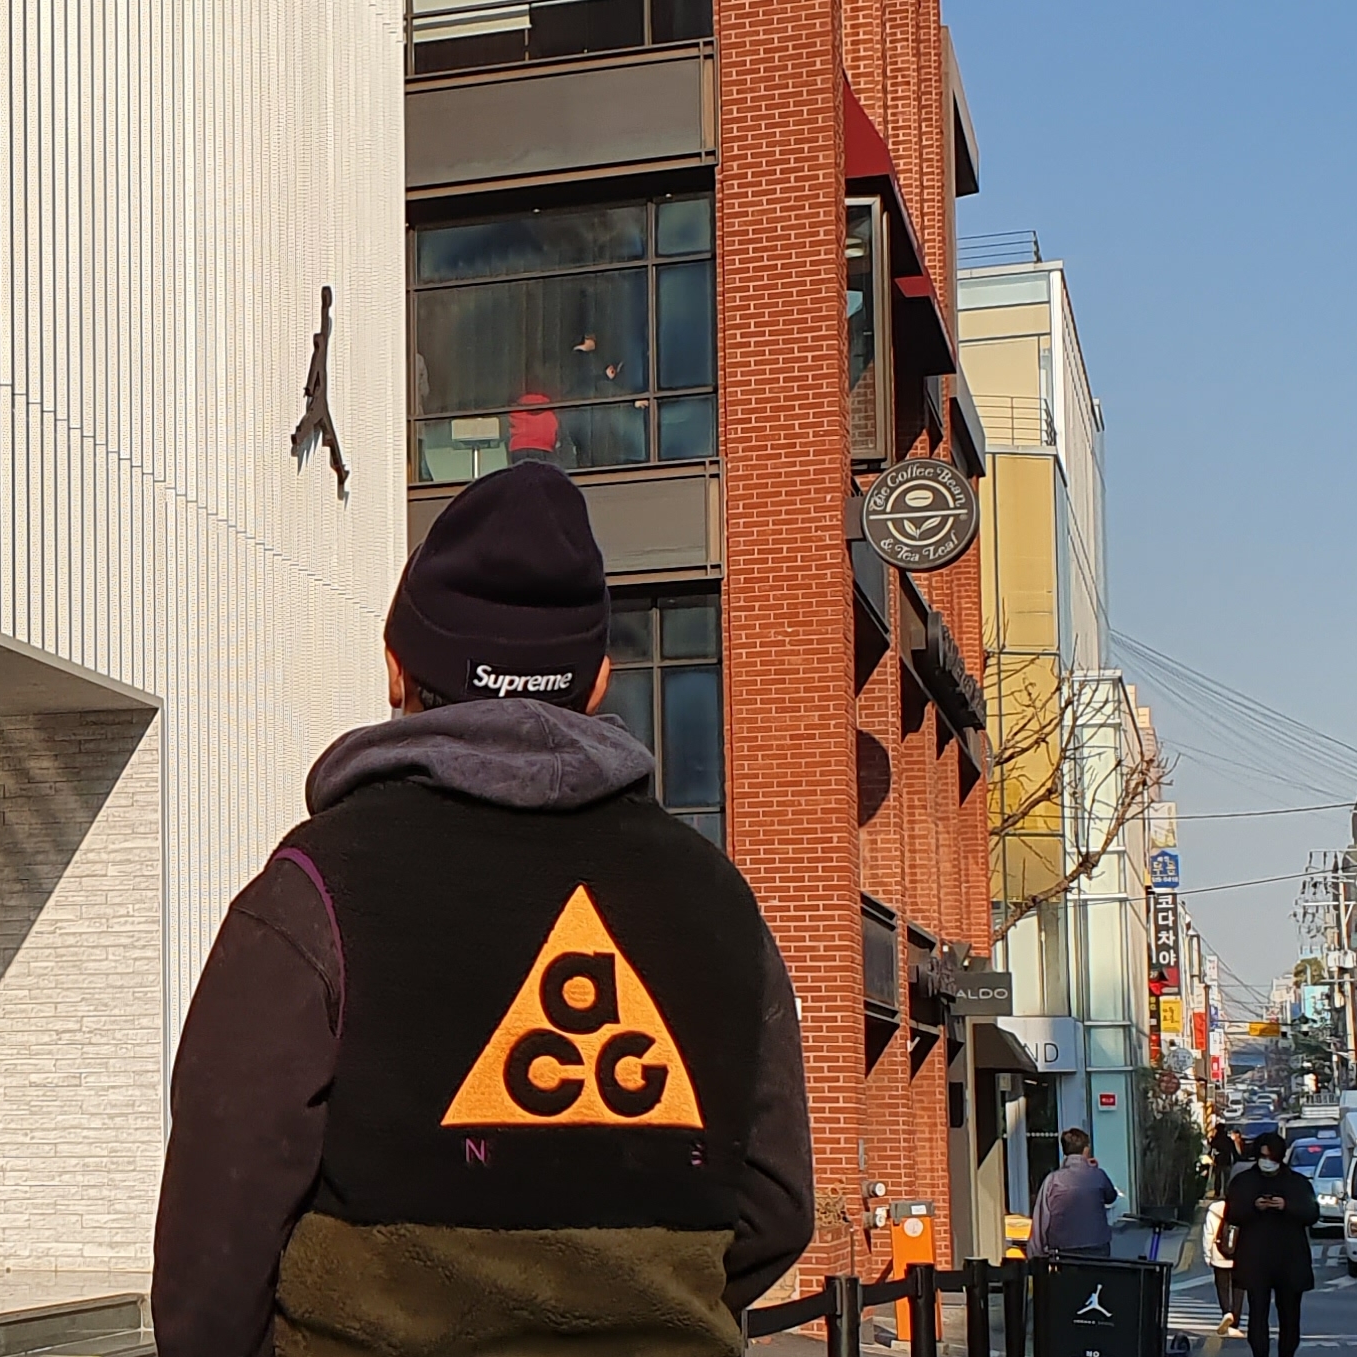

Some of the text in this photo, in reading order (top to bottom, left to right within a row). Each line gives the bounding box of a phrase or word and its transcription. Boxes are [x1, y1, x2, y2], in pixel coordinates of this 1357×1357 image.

[869, 463, 966, 511] The Coffee Bean
[895, 545, 920, 562] Tea
[923, 530, 959, 560] Leaf
[472, 664, 573, 698] Supreme
[955, 988, 1009, 1000] ALDO
[1085, 1350, 1100, 1357] NO
